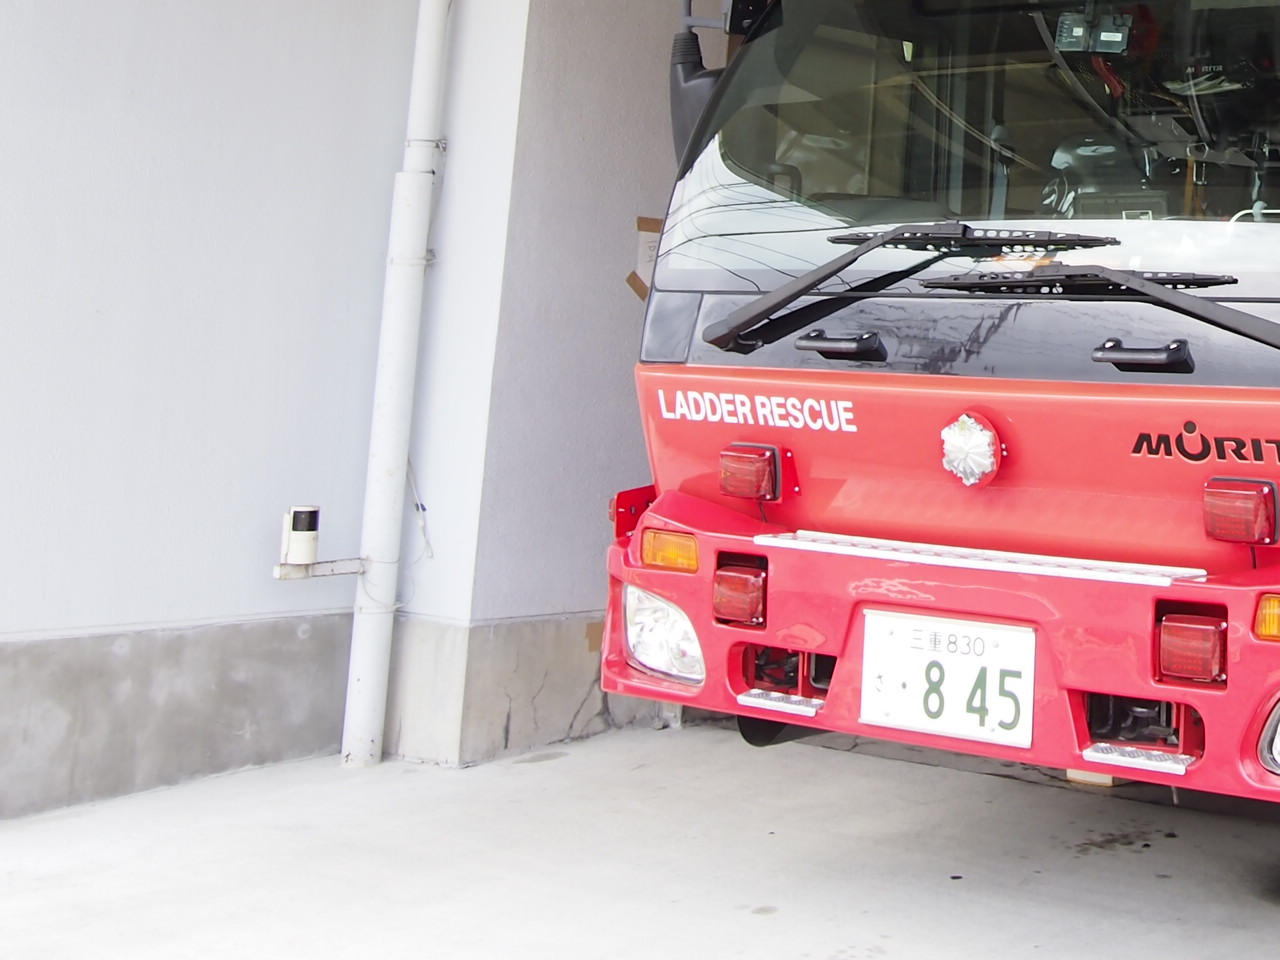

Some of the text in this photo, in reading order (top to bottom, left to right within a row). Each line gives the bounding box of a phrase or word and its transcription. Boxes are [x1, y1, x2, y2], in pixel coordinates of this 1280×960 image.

[1185, 63, 1224, 74] MRITA
[658, 388, 858, 433] LADDER RESCUE
